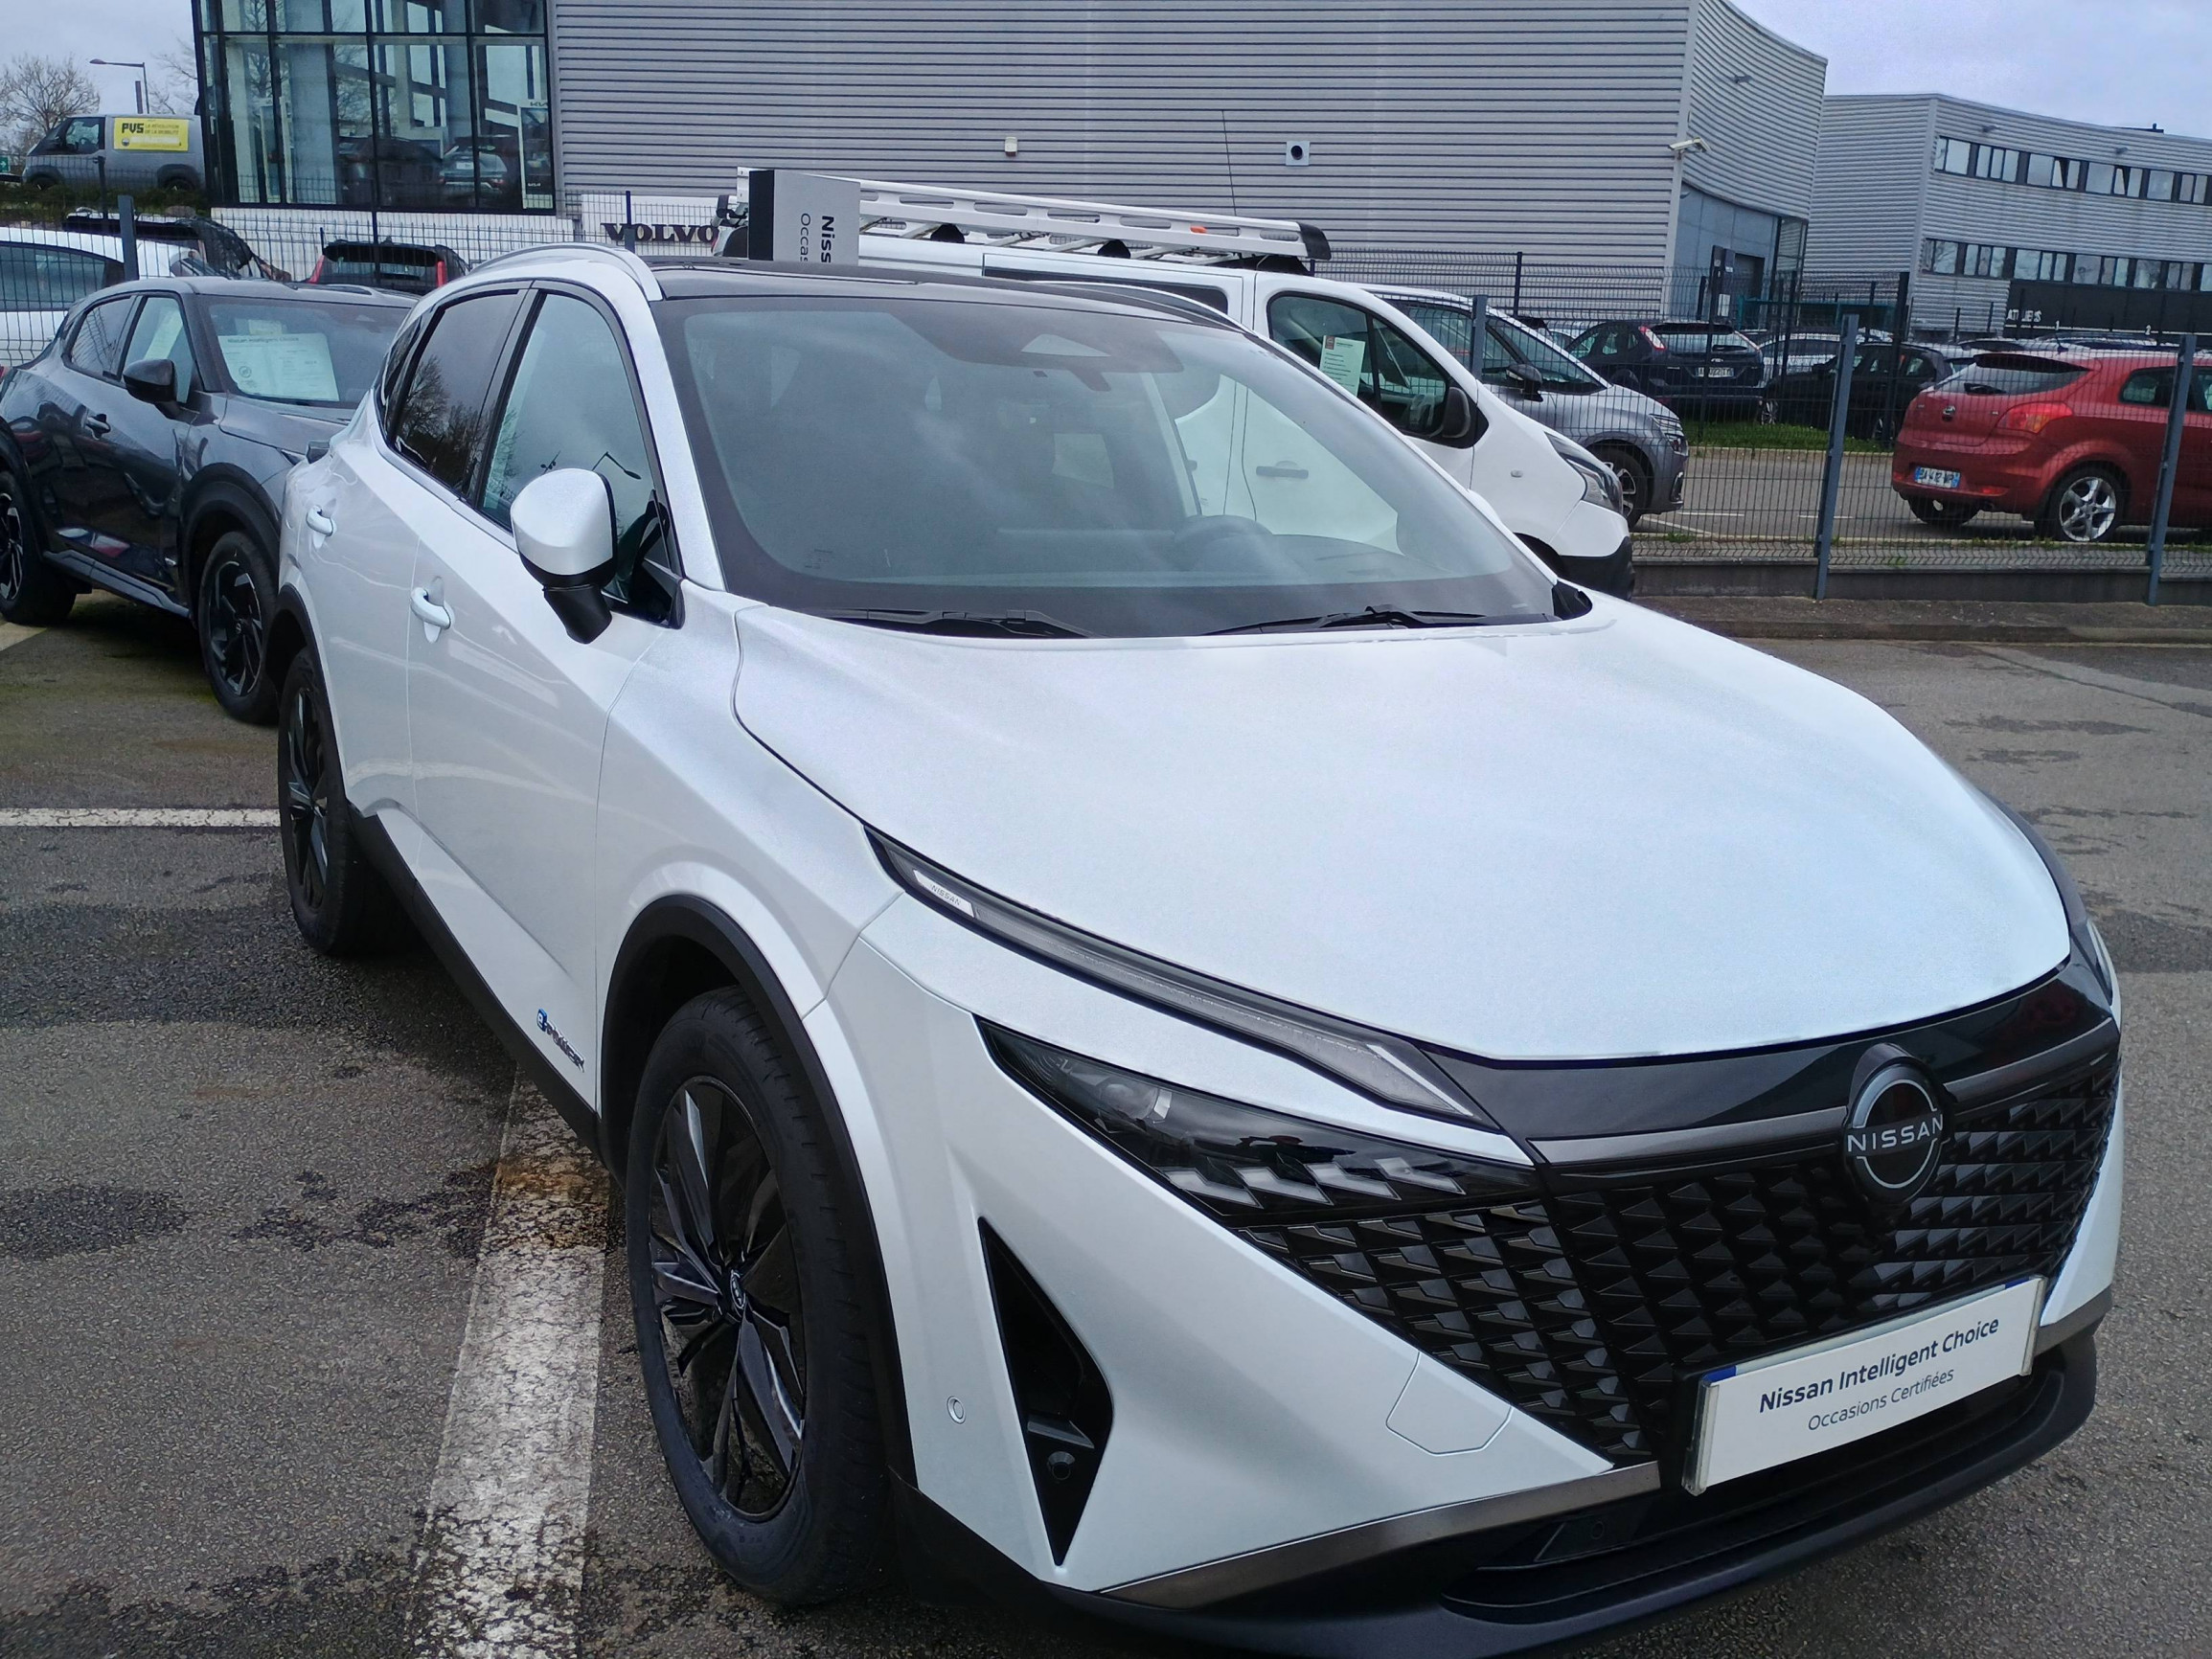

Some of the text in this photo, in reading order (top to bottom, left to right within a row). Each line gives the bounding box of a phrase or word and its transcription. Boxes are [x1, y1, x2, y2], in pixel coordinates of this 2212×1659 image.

[600, 223, 719, 243] VOLVO
[931, 884, 961, 906] NISSAN
[1847, 1113, 1944, 1152] NISSAN
[1759, 1318, 1999, 1414] Nissan Intelligent Choice
[1808, 1368, 1954, 1431] Occasions Certifiées
